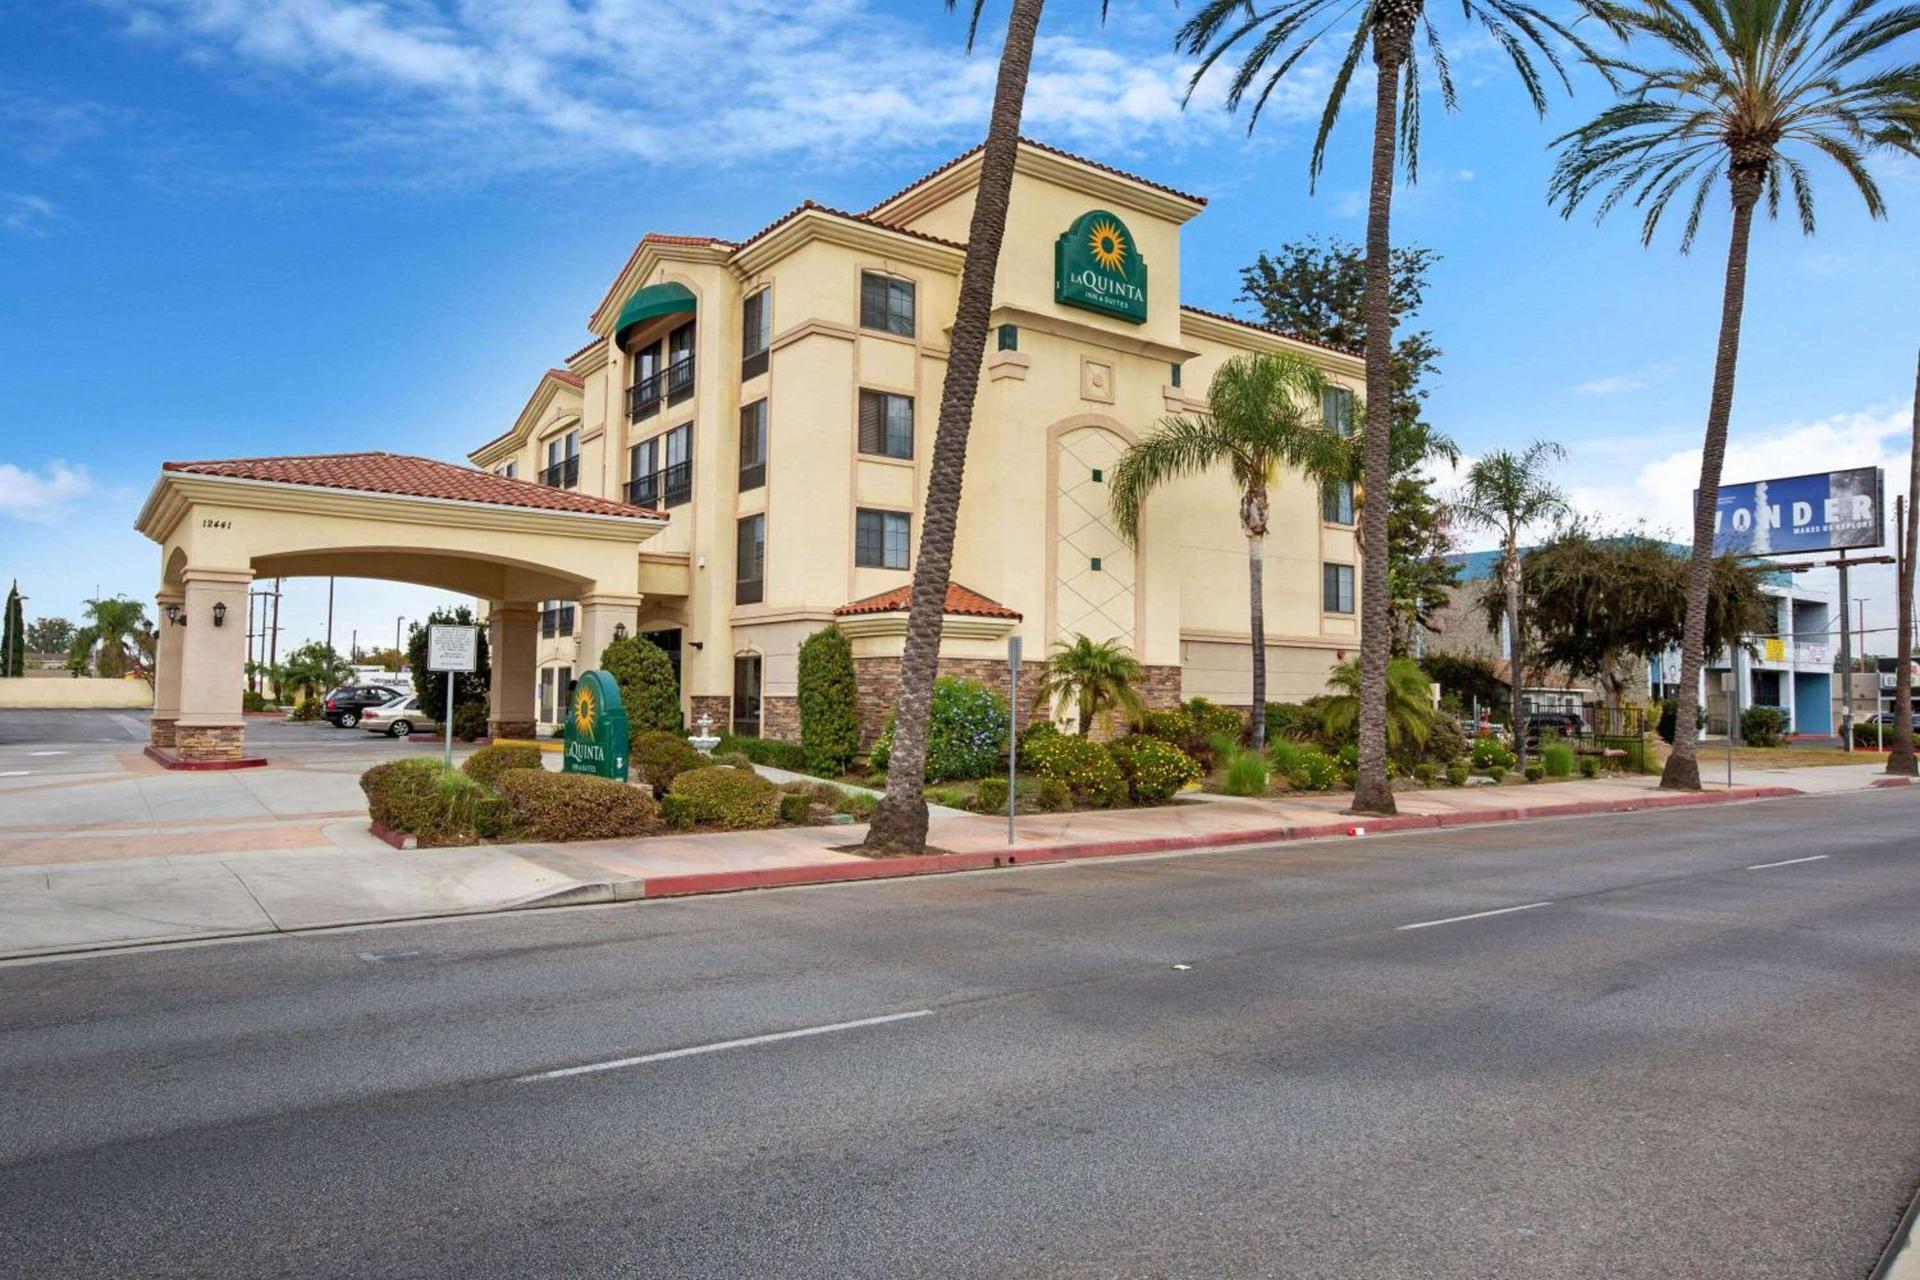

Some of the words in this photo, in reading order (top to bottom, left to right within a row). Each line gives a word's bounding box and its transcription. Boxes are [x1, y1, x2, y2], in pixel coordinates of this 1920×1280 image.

[1071, 272, 1082, 284] LA
[1082, 270, 1144, 302] QUINTA
[1085, 292, 1098, 300] INN
[1104, 296, 1128, 309] SUITES
[202, 519, 231, 530] 12441
[1793, 526, 1820, 535] MAKES
[1836, 520, 1874, 532] EXPLORE
[571, 741, 605, 762] QUINTA
